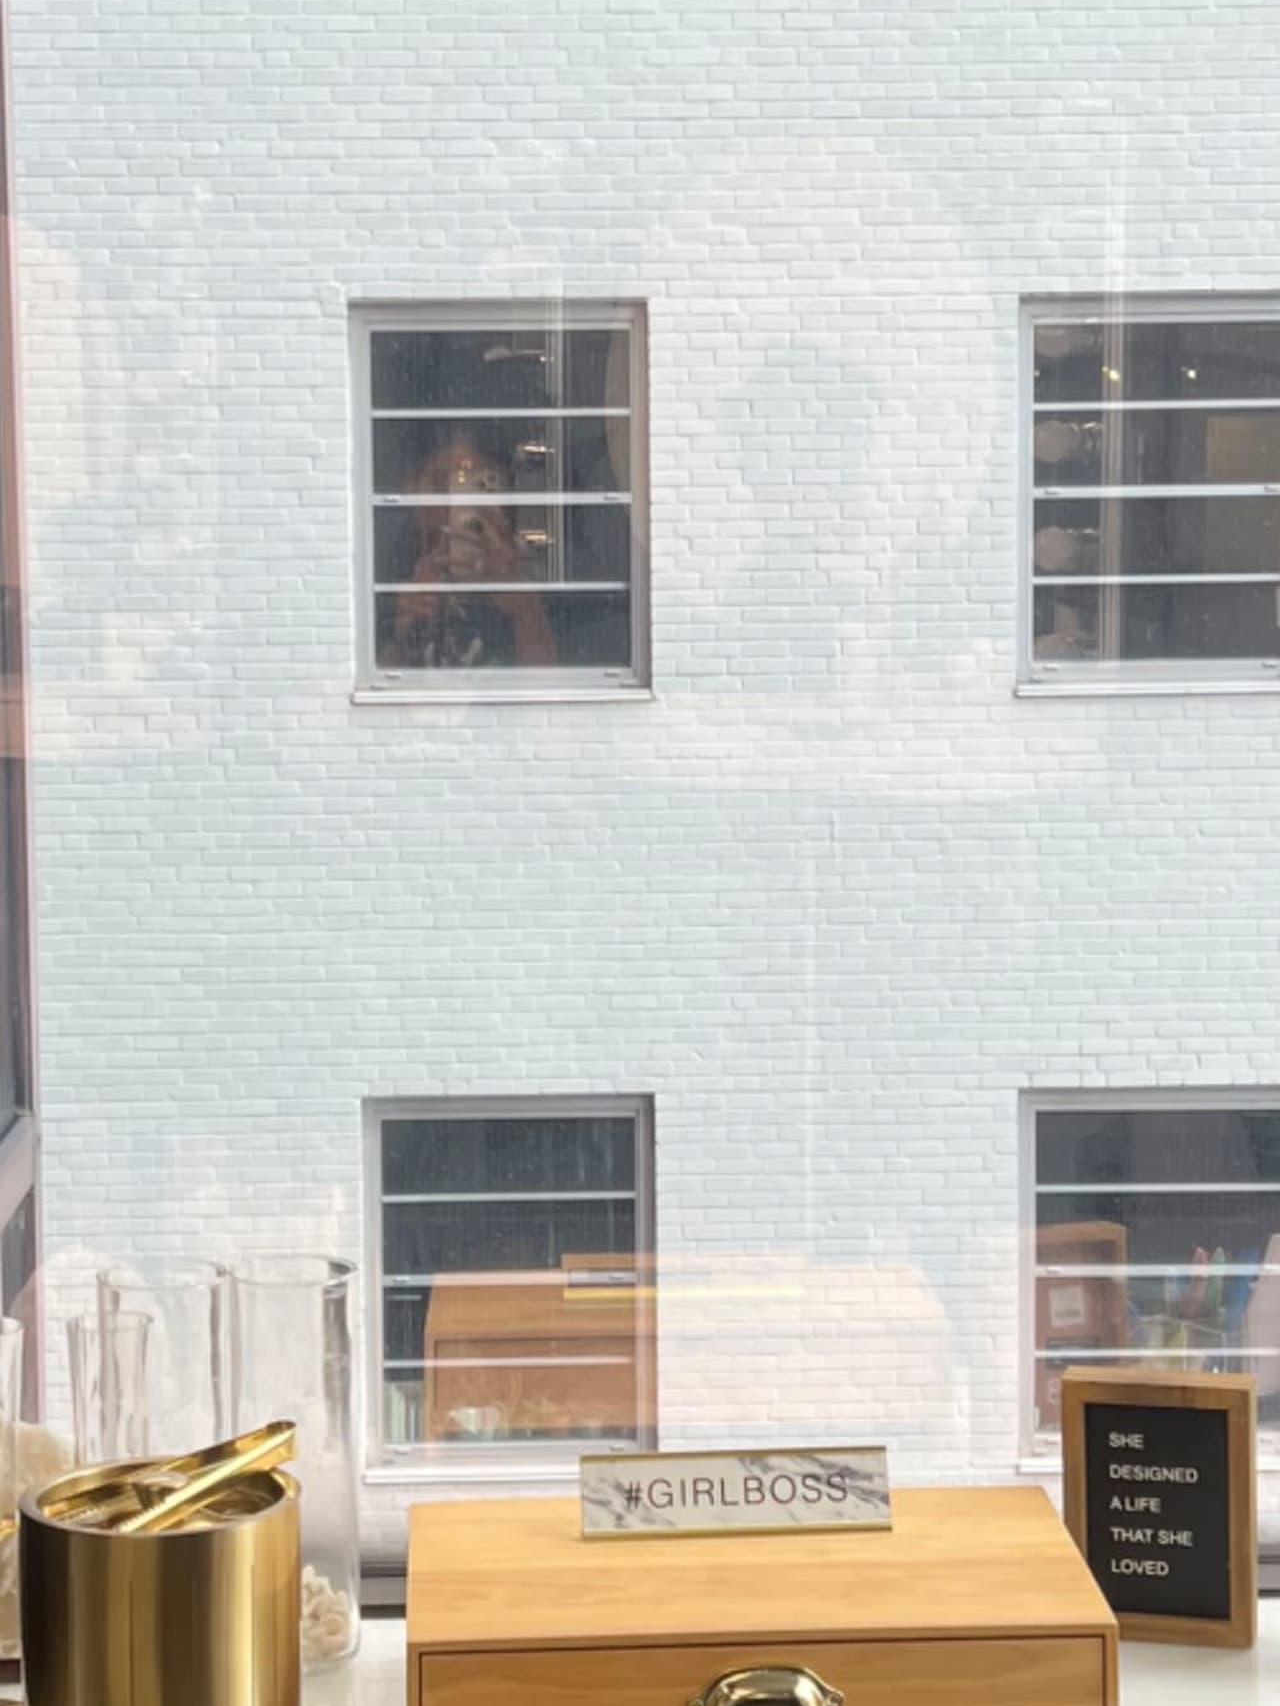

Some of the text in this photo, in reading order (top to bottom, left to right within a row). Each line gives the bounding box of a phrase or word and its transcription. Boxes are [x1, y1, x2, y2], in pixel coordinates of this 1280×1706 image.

[1108, 1431, 1145, 1450] SHE
[1108, 1463, 1199, 1484] DESIGNED
[624, 1472, 849, 1510] #GIRLBOSS
[1109, 1494, 1162, 1514] A LIFE
[1109, 1525, 1194, 1547] THAT SHE
[1110, 1558, 1170, 1576] LOVED
